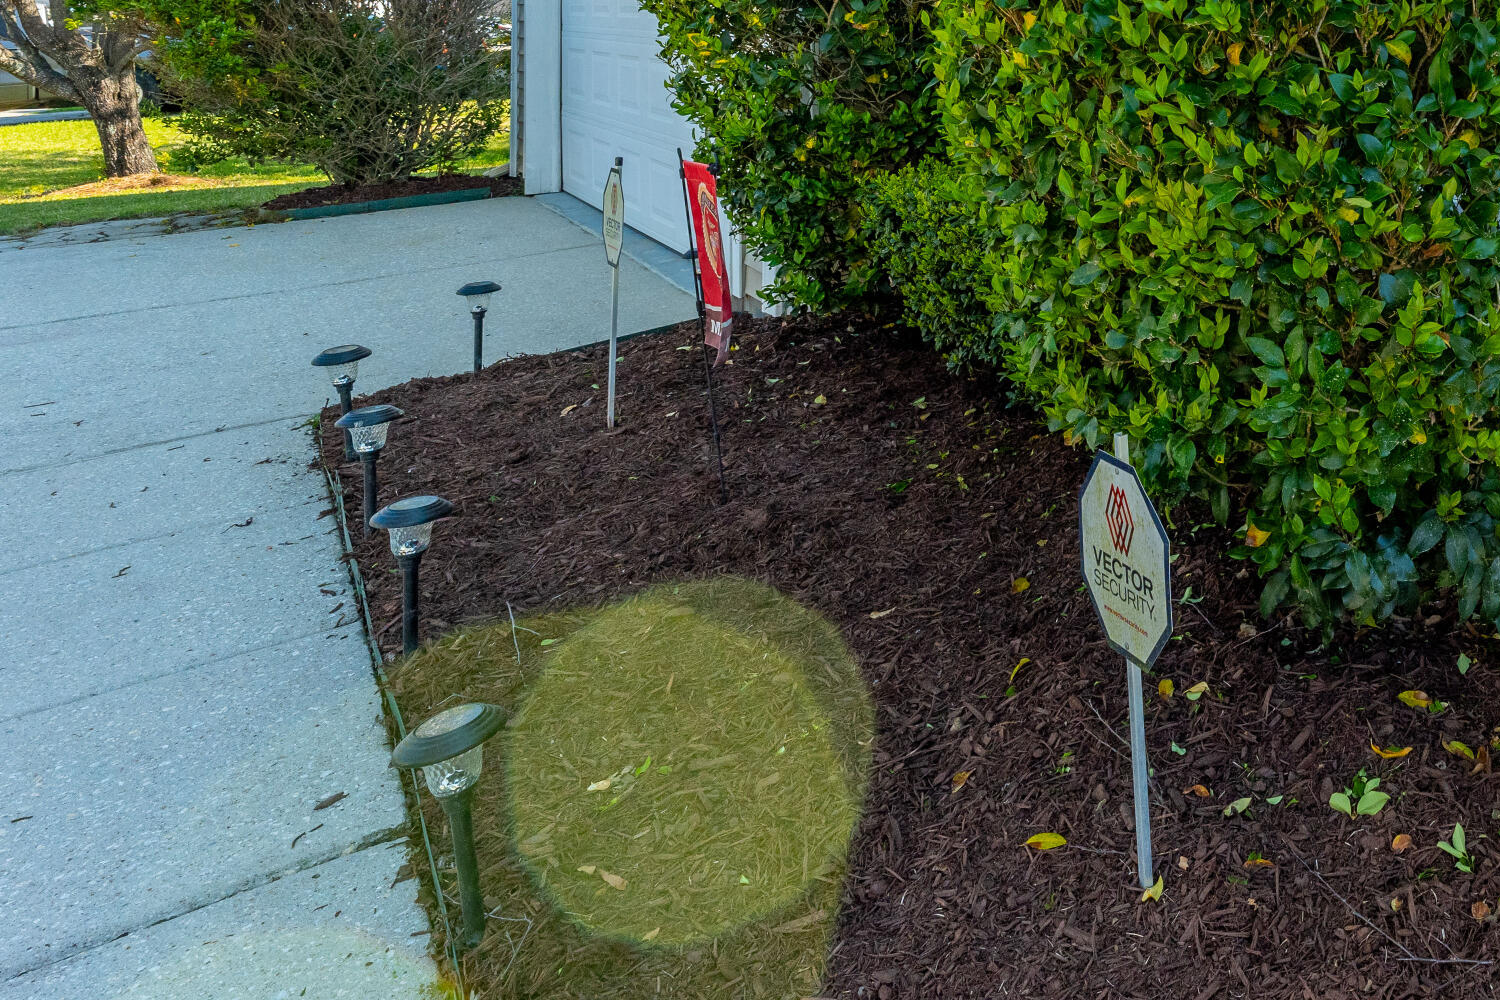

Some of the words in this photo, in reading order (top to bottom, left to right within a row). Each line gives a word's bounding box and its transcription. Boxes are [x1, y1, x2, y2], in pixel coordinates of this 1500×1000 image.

[606, 217, 621, 231] VECTOR
[1092, 545, 1154, 600] VECTOR
[1094, 568, 1156, 621] SECURITY
